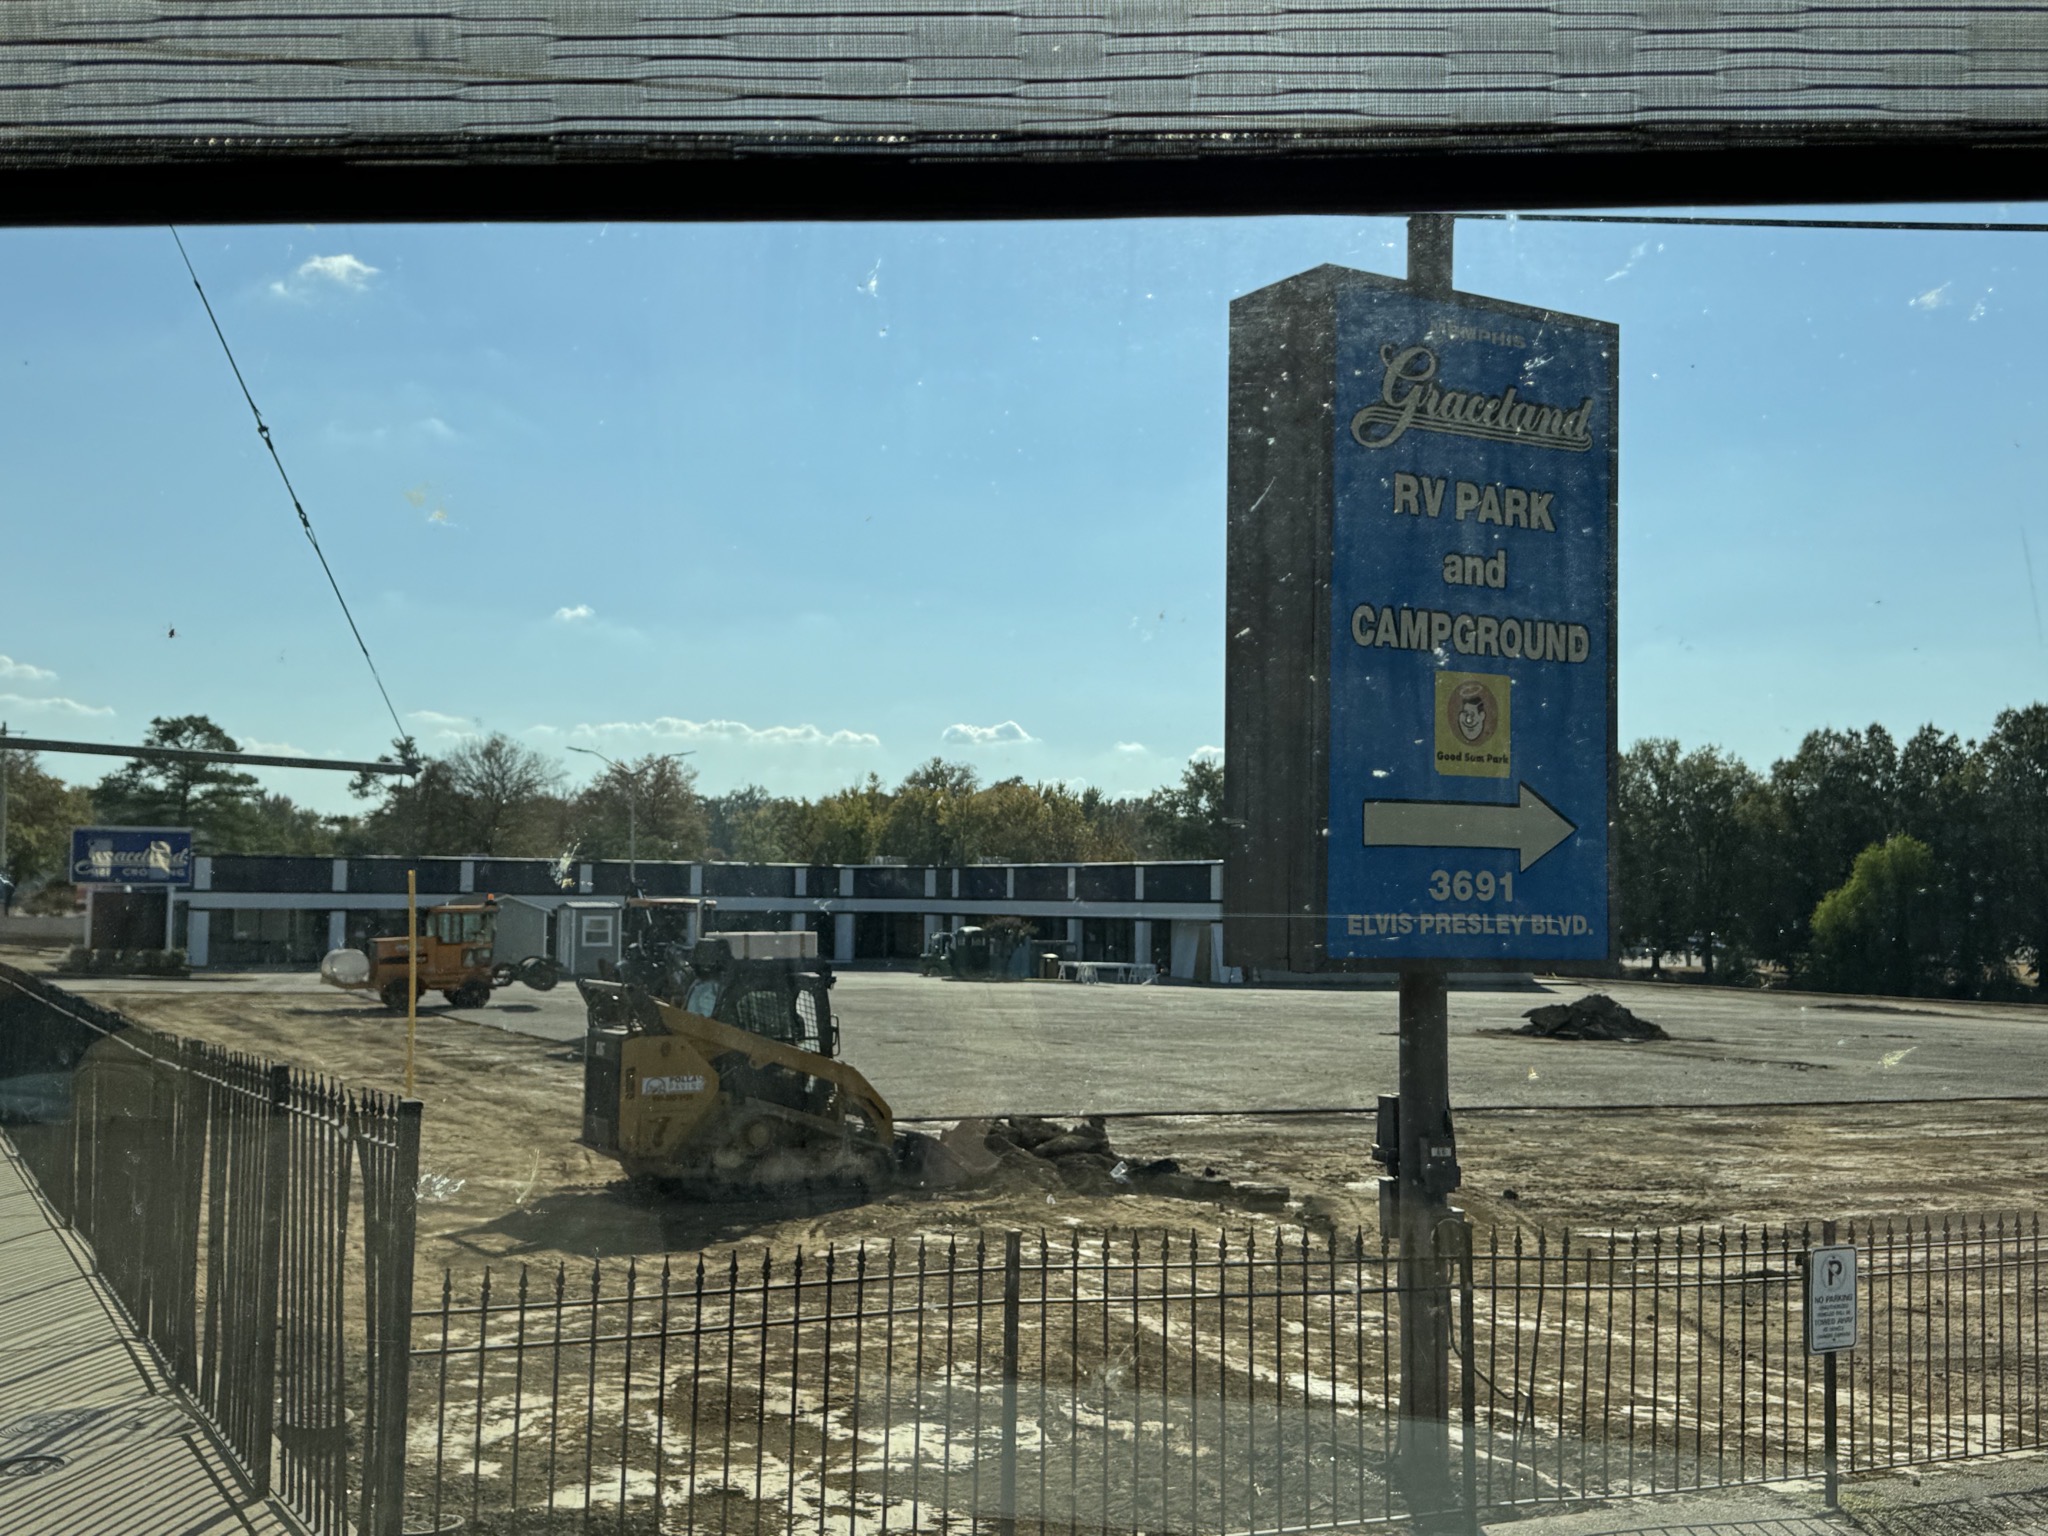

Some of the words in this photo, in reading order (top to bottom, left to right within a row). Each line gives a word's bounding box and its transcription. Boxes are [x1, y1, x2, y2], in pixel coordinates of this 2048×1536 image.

[1430, 319, 1527, 349] MEMPHIS
[1351, 344, 1593, 451] Graceland
[1394, 472, 1448, 517] RV
[1455, 481, 1556, 532] PARK
[1443, 549, 1507, 588] and
[1351, 604, 1590, 663] CAMPGROUND
[1436, 751, 1462, 762] Good
[1487, 753, 1509, 764] Park
[1429, 869, 1513, 901] 3691
[1348, 913, 1414, 936] ELVIS
[1420, 914, 1524, 936] PRESLEY
[1531, 915, 1594, 936] BLVD.
